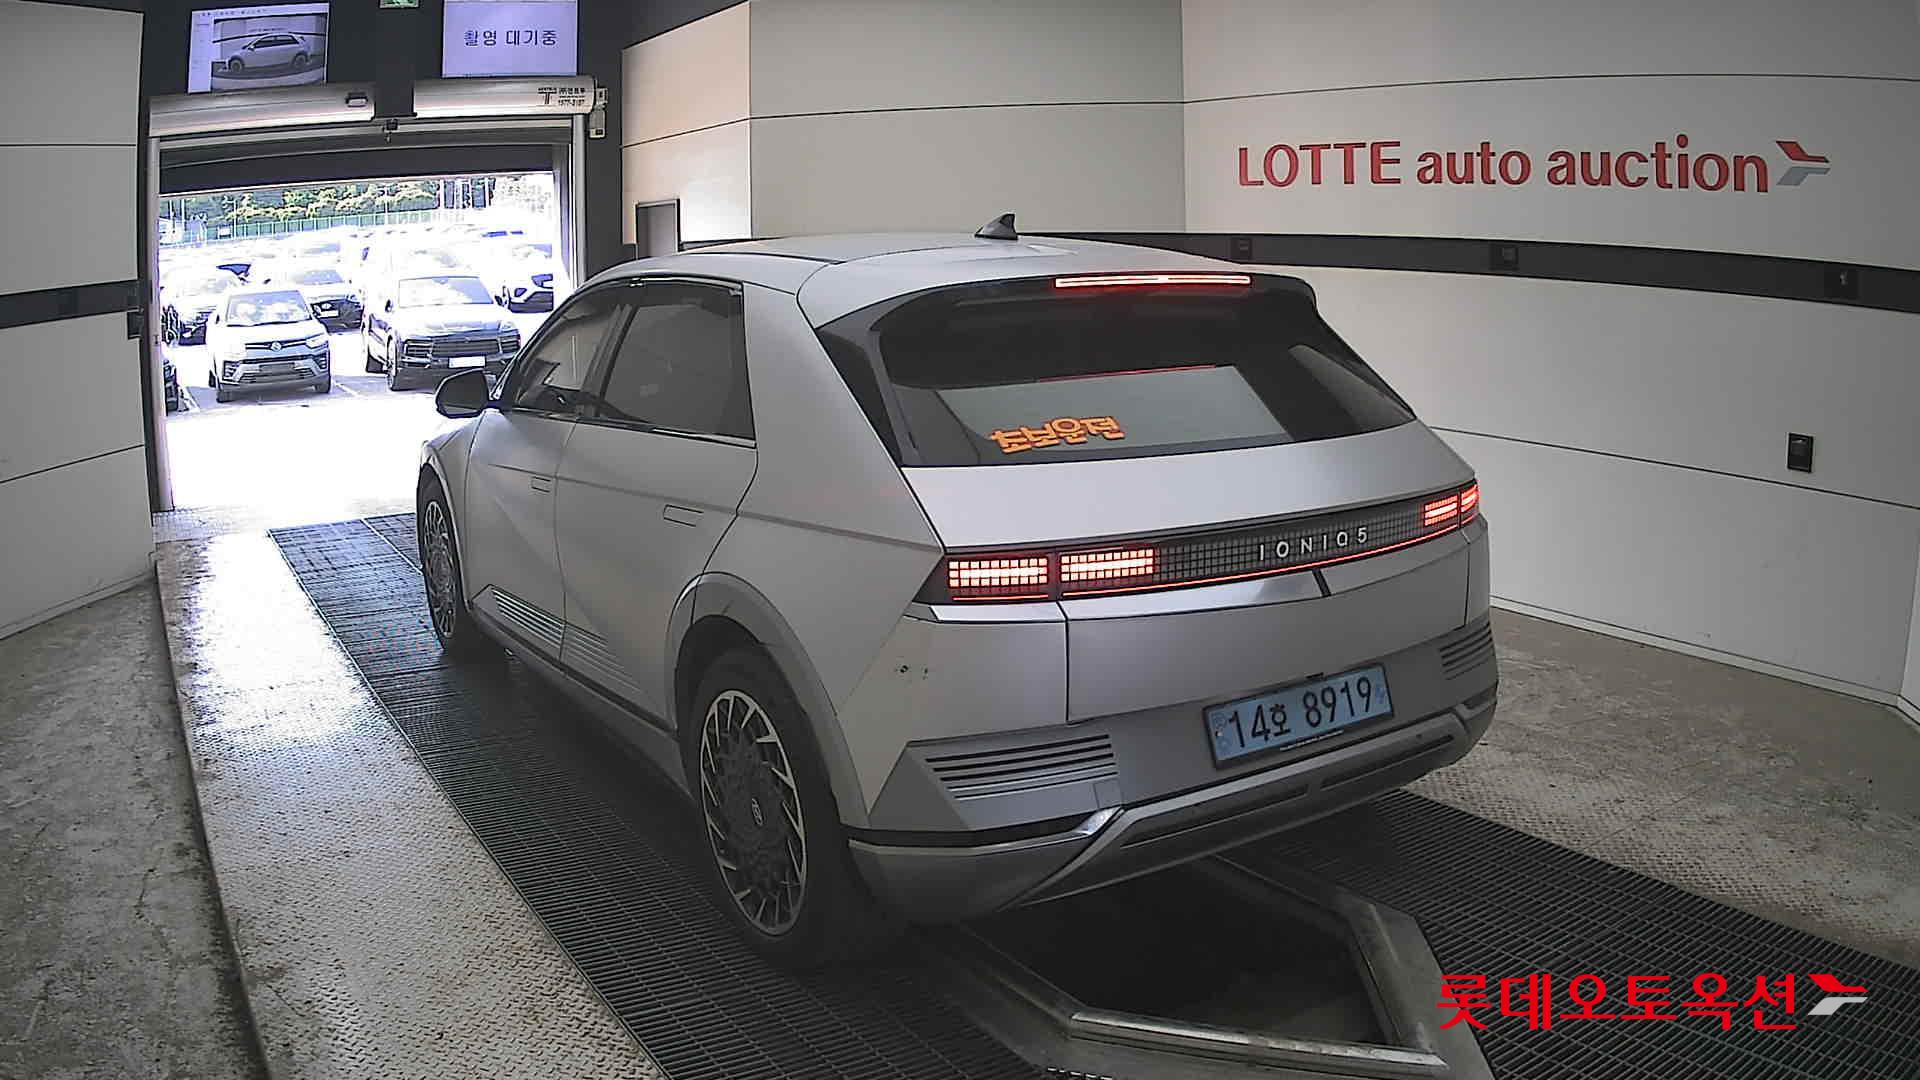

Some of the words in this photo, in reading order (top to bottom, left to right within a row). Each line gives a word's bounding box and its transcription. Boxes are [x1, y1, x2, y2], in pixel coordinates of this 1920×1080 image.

[464, 30, 497, 46] 촬영
[506, 30, 557, 46] 대기중
[1238, 140, 1400, 187] LOTTE
[1416, 141, 1532, 186] auto
[1546, 134, 1769, 193] auction
[990, 416, 1125, 454] 초보운전
[1228, 703, 1292, 749] 14호
[1302, 676, 1372, 728] 8919
